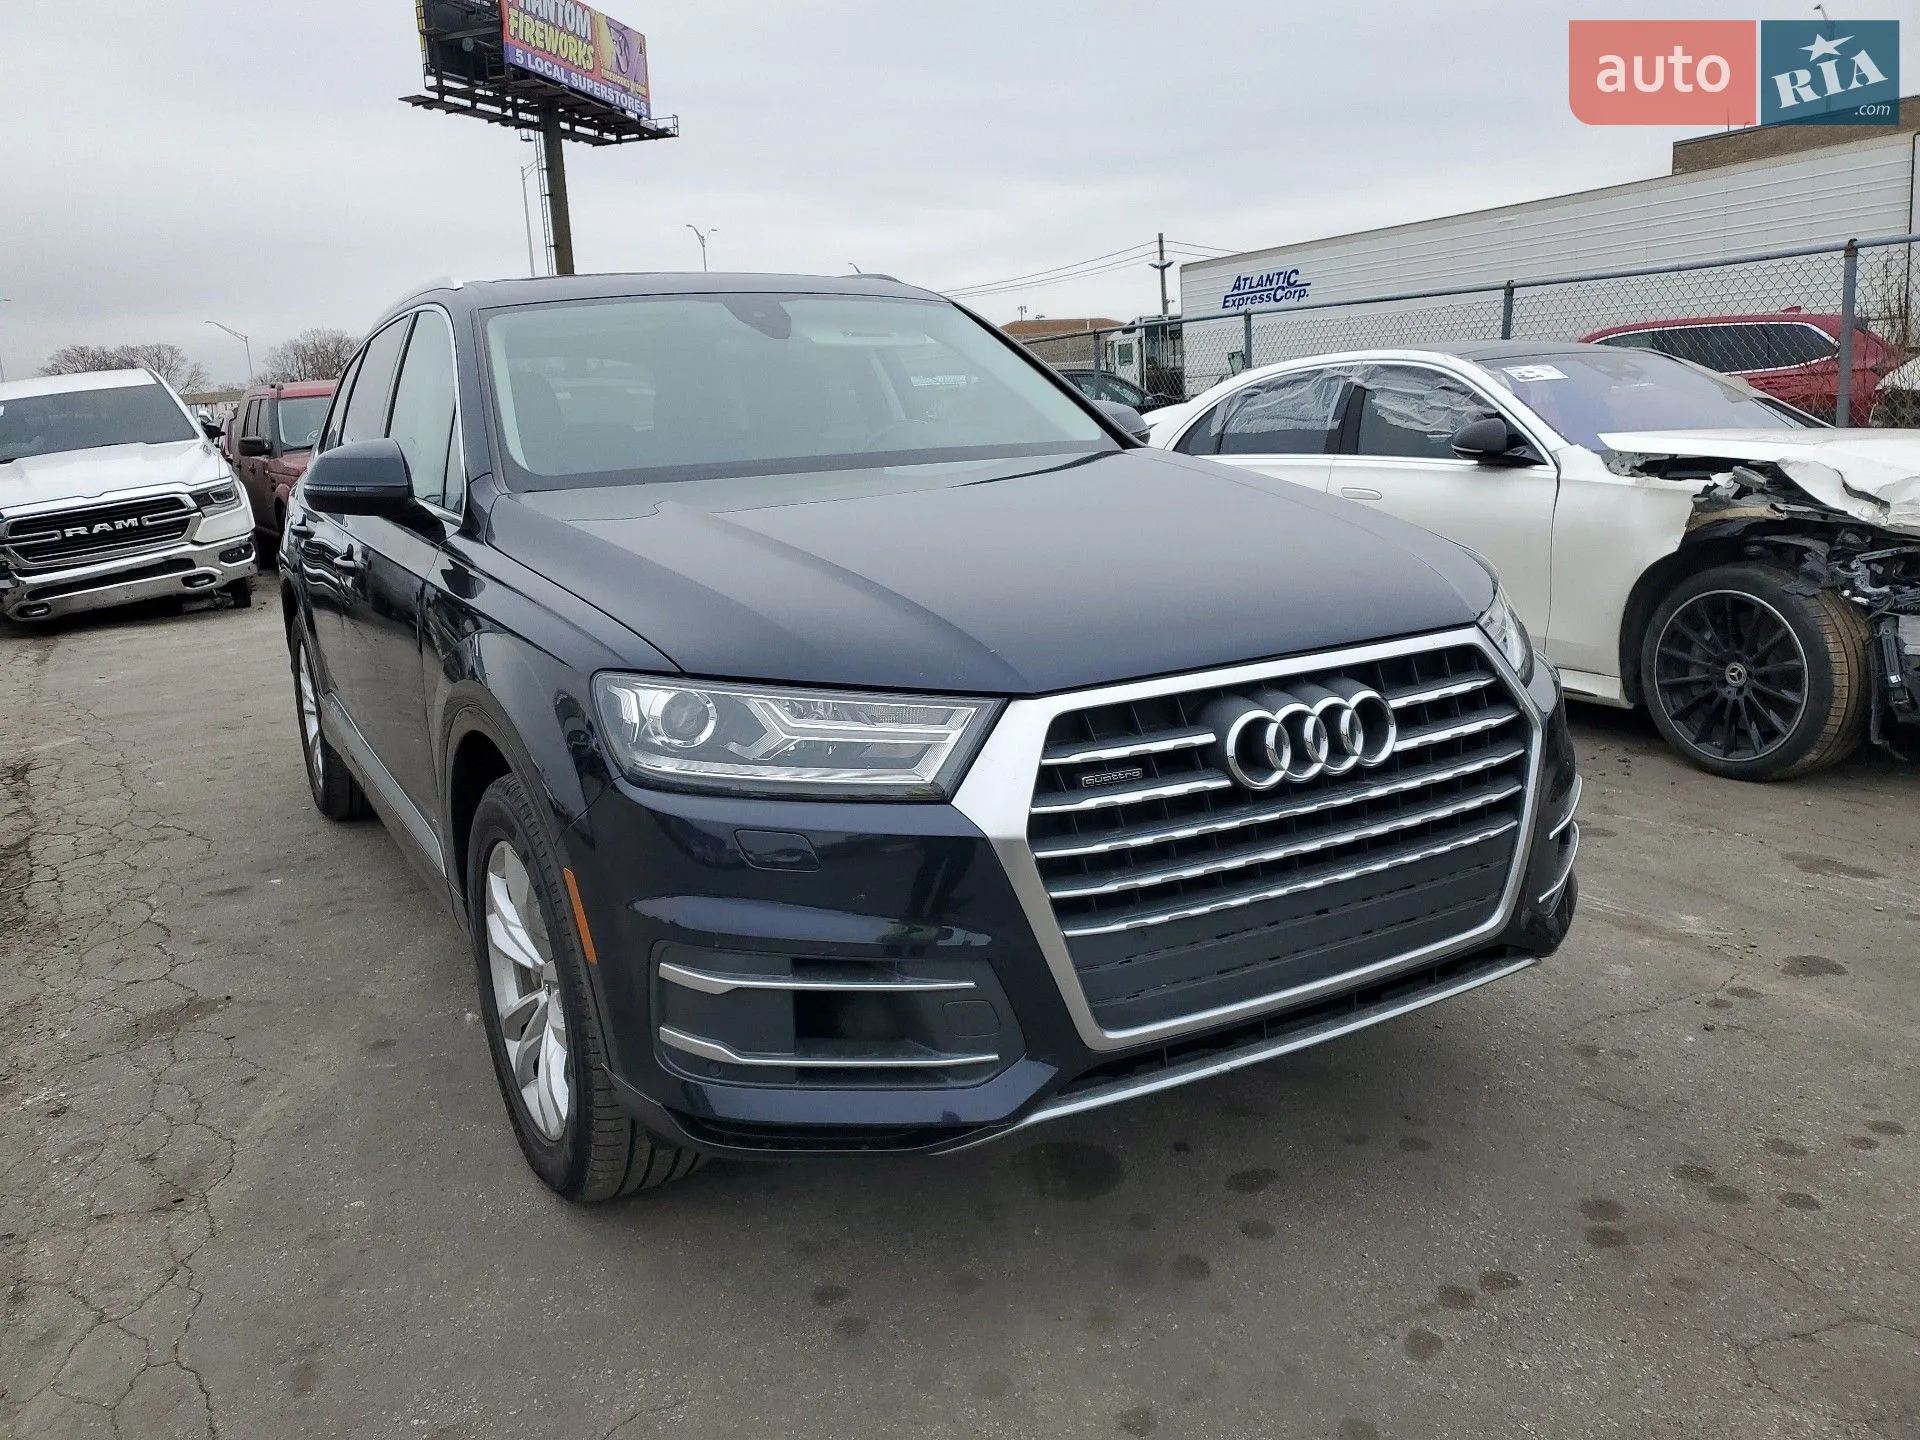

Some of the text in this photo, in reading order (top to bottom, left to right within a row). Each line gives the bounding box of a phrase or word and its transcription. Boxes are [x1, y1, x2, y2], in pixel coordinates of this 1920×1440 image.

[508, 7, 595, 70] FIREWORKS
[515, 48, 524, 65] 5
[526, 53, 569, 82] LOCAL
[570, 71, 647, 116] SUPERSTORES
[1231, 269, 1300, 292] ATLANTIC
[64, 517, 139, 538] RAM
